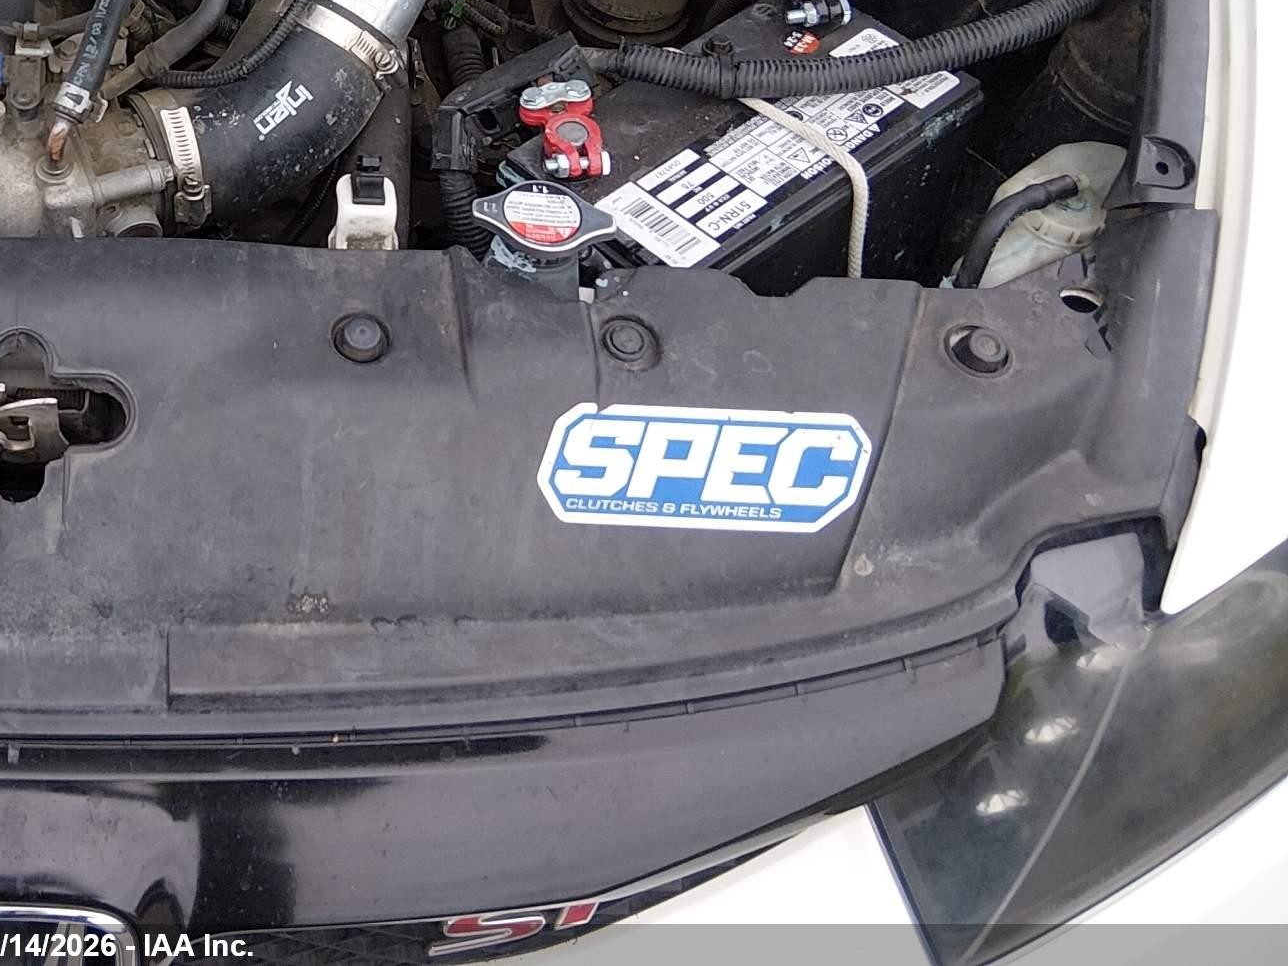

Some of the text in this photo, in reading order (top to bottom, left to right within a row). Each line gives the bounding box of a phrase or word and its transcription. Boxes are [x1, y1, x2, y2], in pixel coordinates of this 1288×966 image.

[697, 192, 715, 205] 500
[707, 200, 752, 231] 51RN-C
[553, 418, 860, 508] SPEC
[565, 496, 783, 520] CLUTCHES & FLYWHEELS
